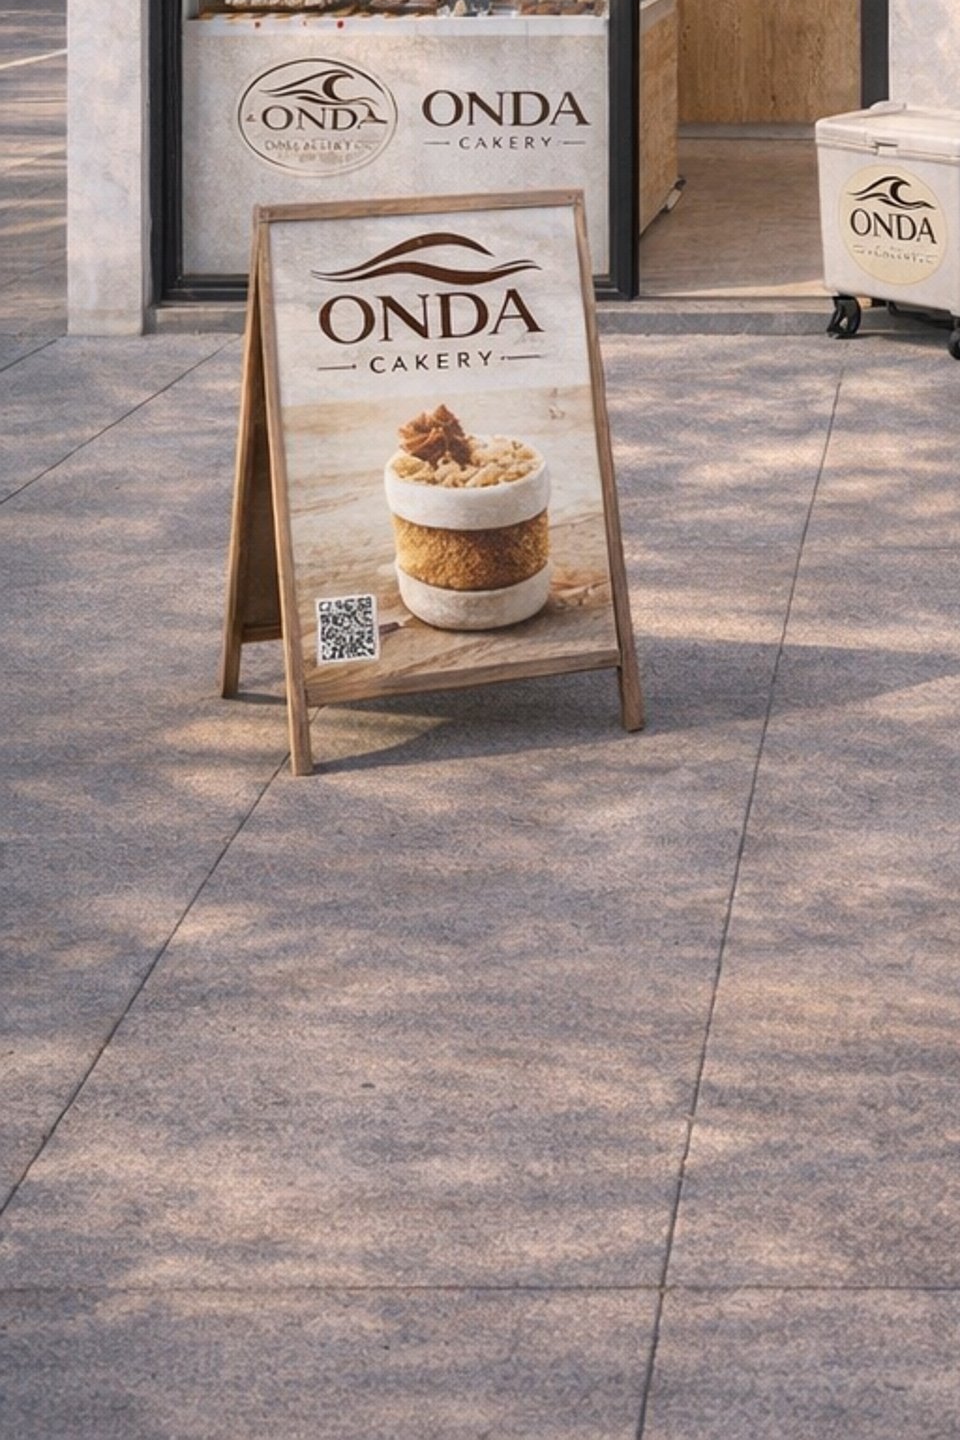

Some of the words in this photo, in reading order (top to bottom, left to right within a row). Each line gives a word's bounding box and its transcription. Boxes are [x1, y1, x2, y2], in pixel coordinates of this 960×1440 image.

[421, 90, 591, 127] ONDA
[458, 135, 552, 150] CAKERY
[850, 207, 937, 245] ONDA
[318, 287, 545, 345] ONDA
[369, 350, 492, 374] CAKERY
